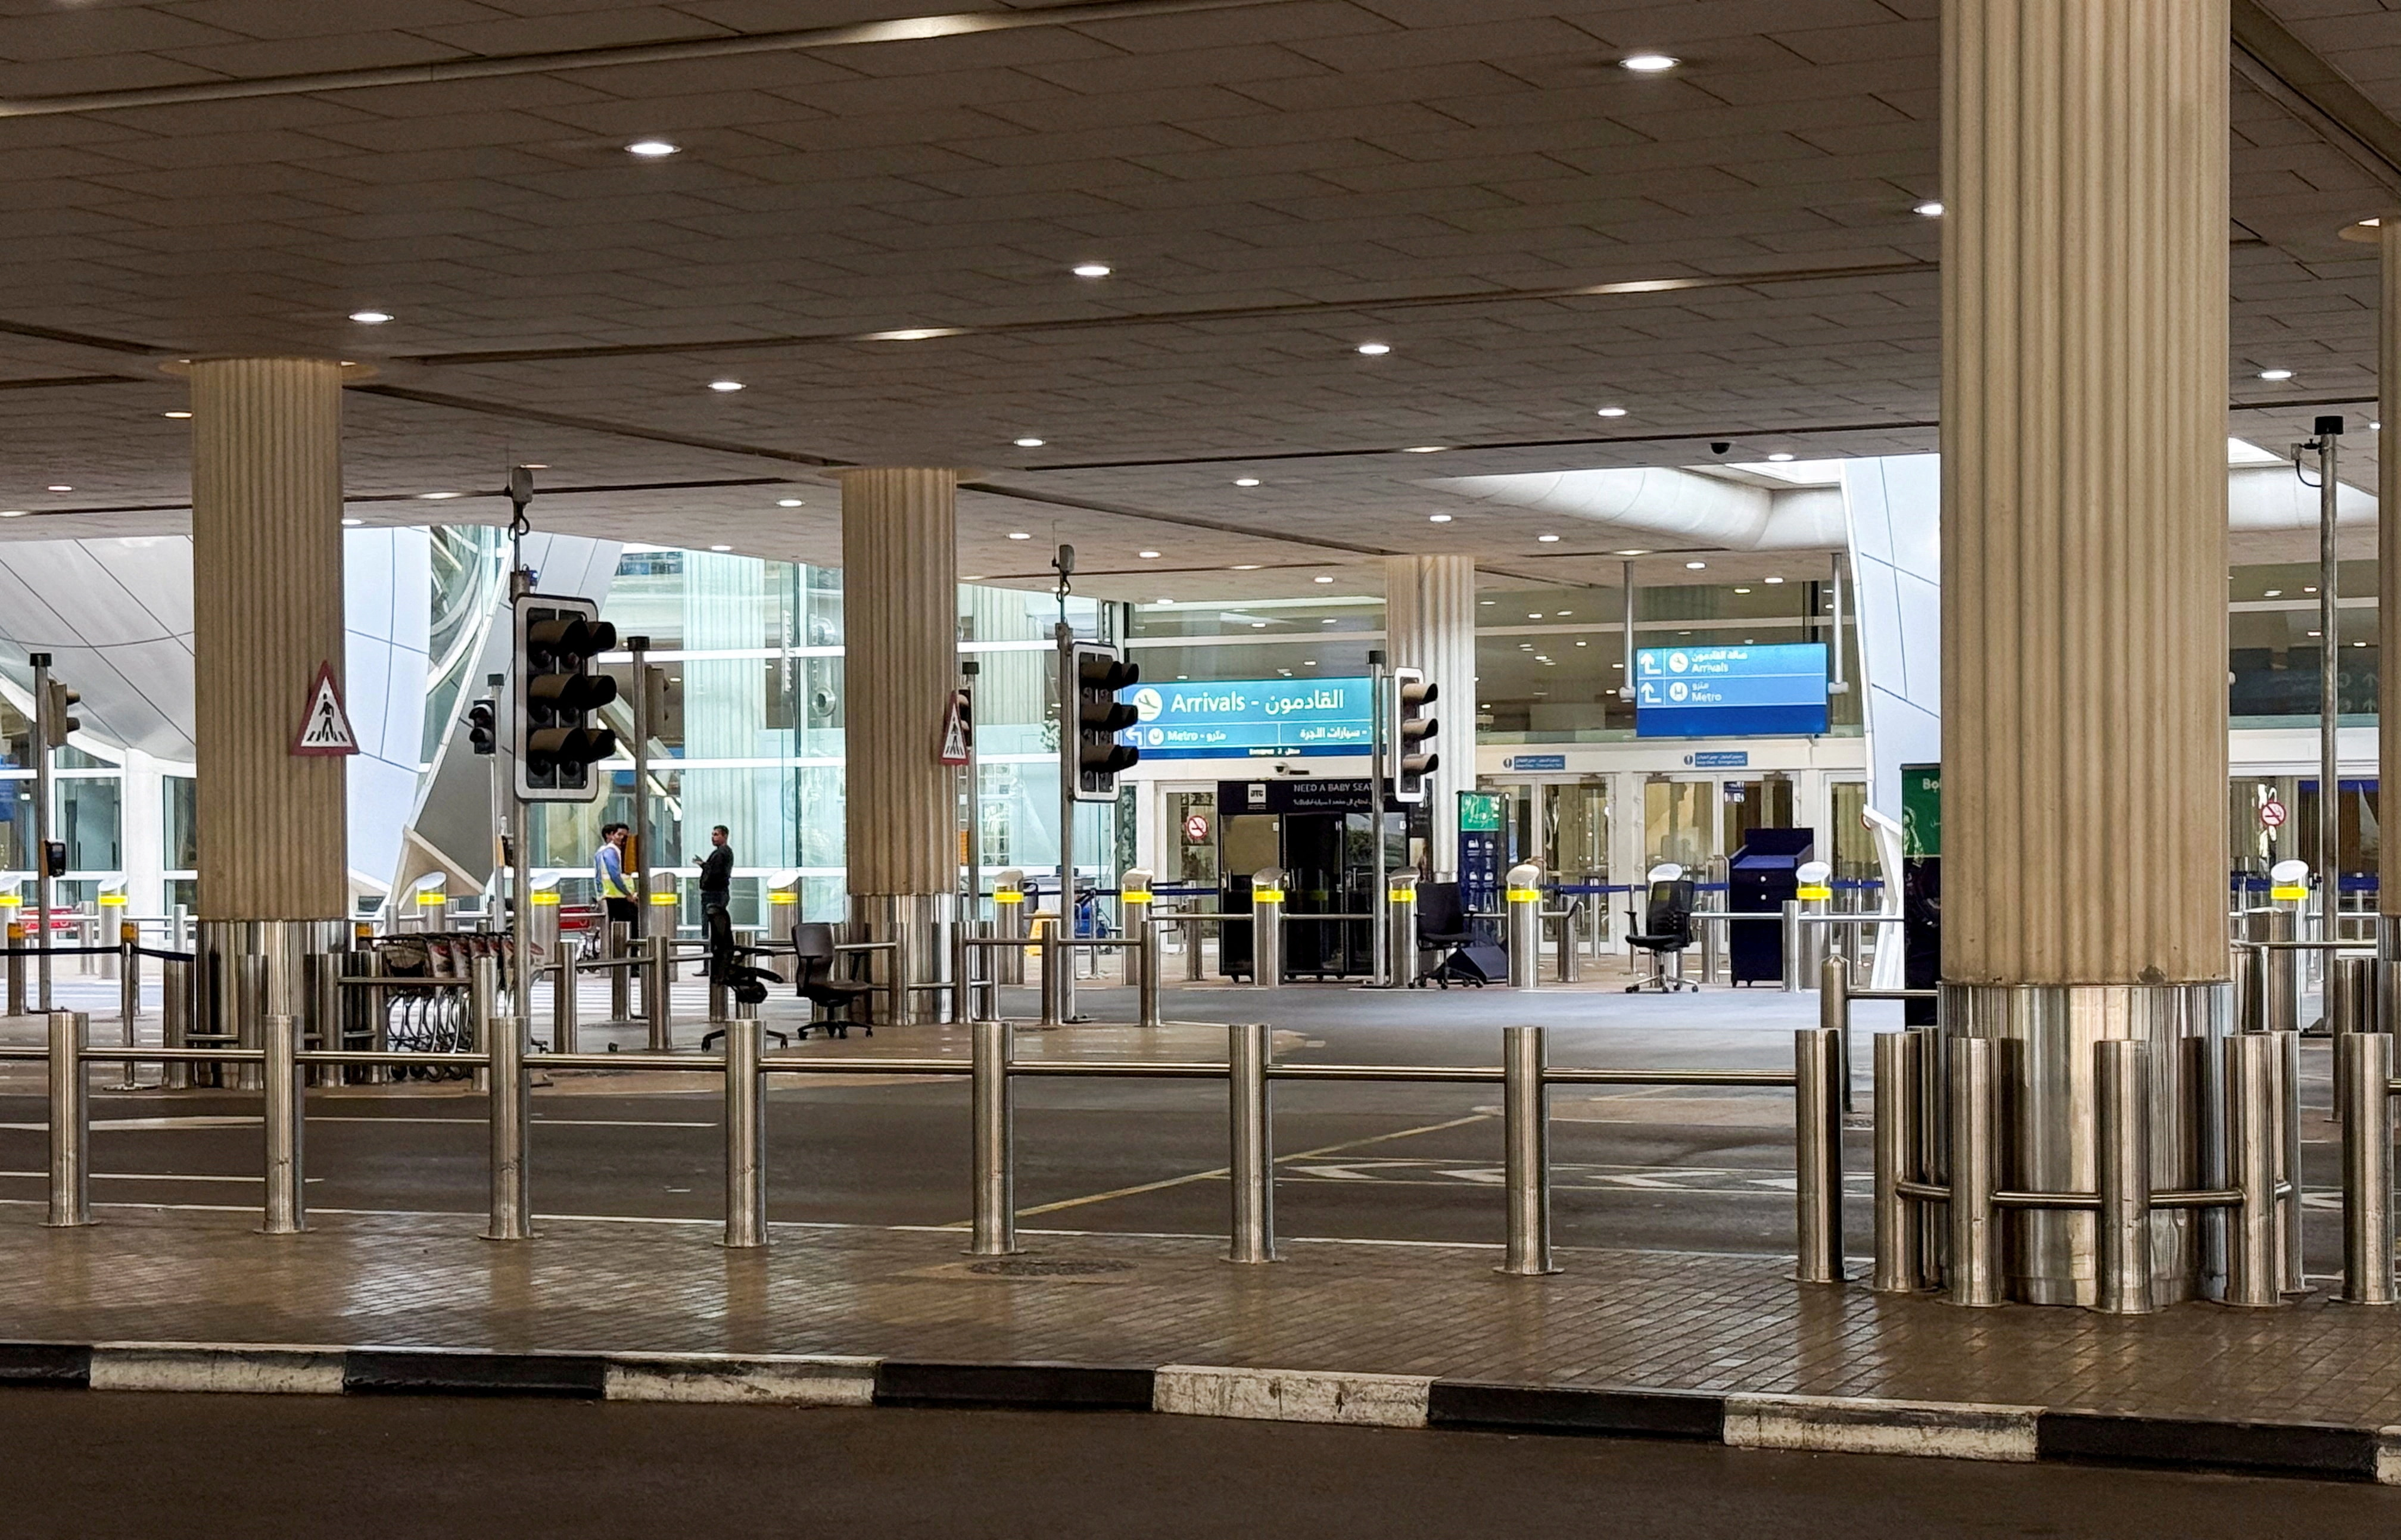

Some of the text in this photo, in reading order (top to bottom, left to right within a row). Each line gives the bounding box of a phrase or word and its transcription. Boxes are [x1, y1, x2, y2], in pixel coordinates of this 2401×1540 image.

[1692, 662, 1729, 673] Arrivals
[1170, 691, 1246, 713] Arrivals
[1265, 688, 1344, 715] القادمون
[1692, 692, 1722, 702] Metro
[1167, 731, 1198, 741] Metro
[1206, 730, 1226, 742] مترو
[1326, 726, 1360, 740] سيارات
[1294, 784, 1318, 792] NEED
[1328, 783, 1350, 791] BABY
